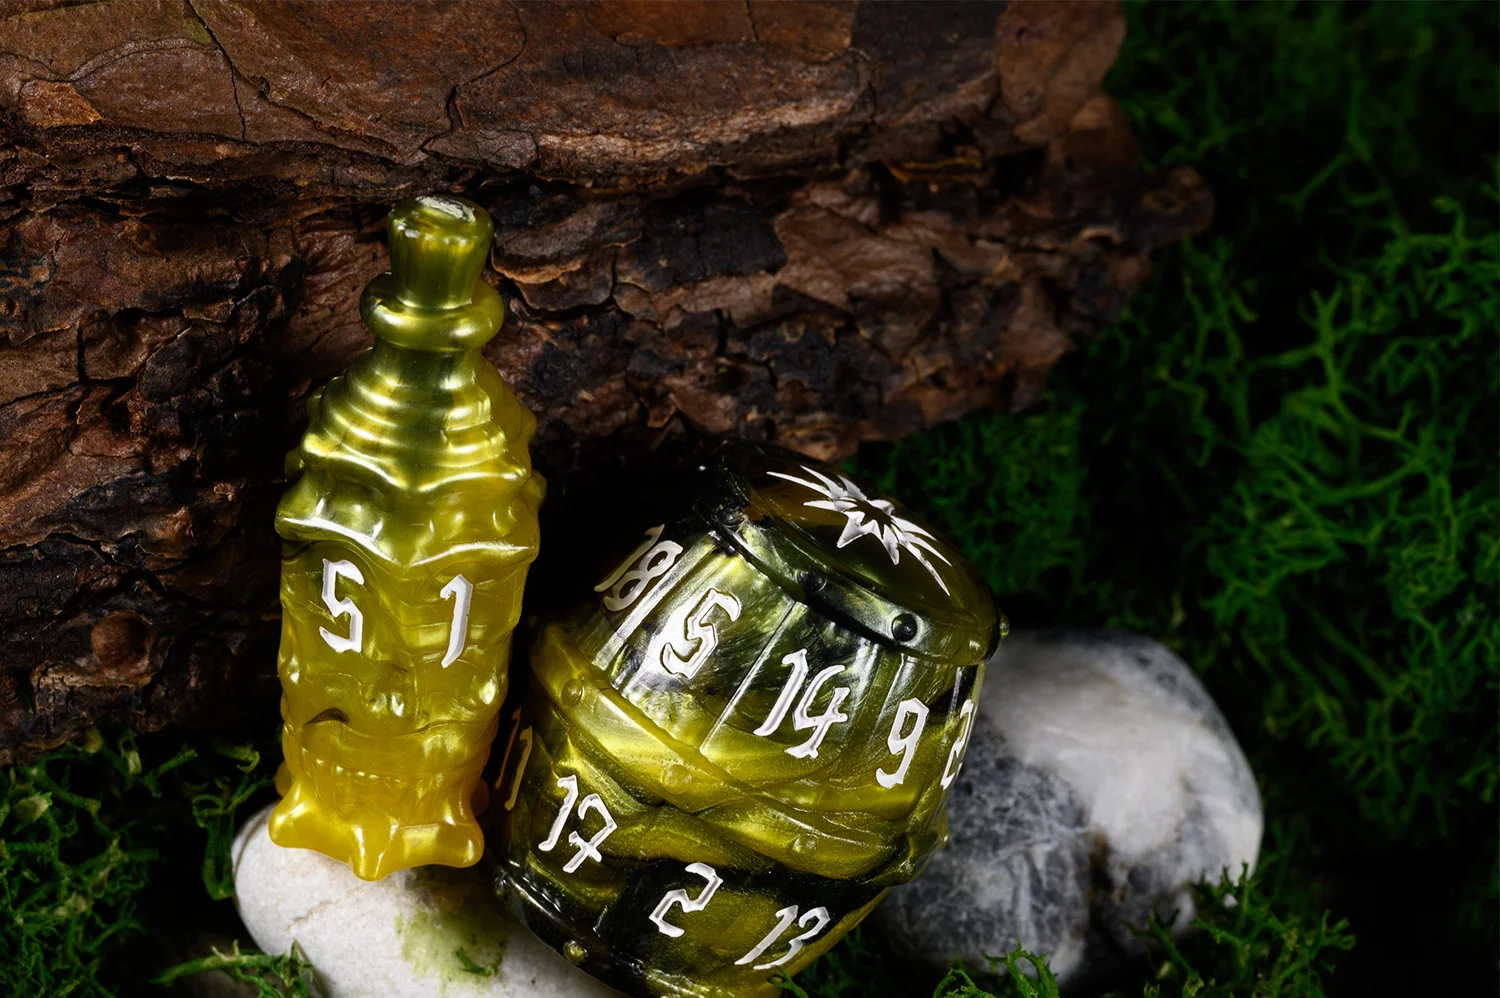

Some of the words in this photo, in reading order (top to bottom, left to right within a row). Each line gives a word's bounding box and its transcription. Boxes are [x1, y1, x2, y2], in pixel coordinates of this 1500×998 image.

[319, 556, 366, 656] 5
[592, 522, 685, 612] 18
[439, 572, 474, 669] 1
[655, 586, 742, 681] 5
[753, 648, 850, 759] 14
[875, 697, 930, 789] 9
[537, 774, 620, 876] 17
[646, 862, 725, 940] 2
[733, 904, 832, 972] 13
